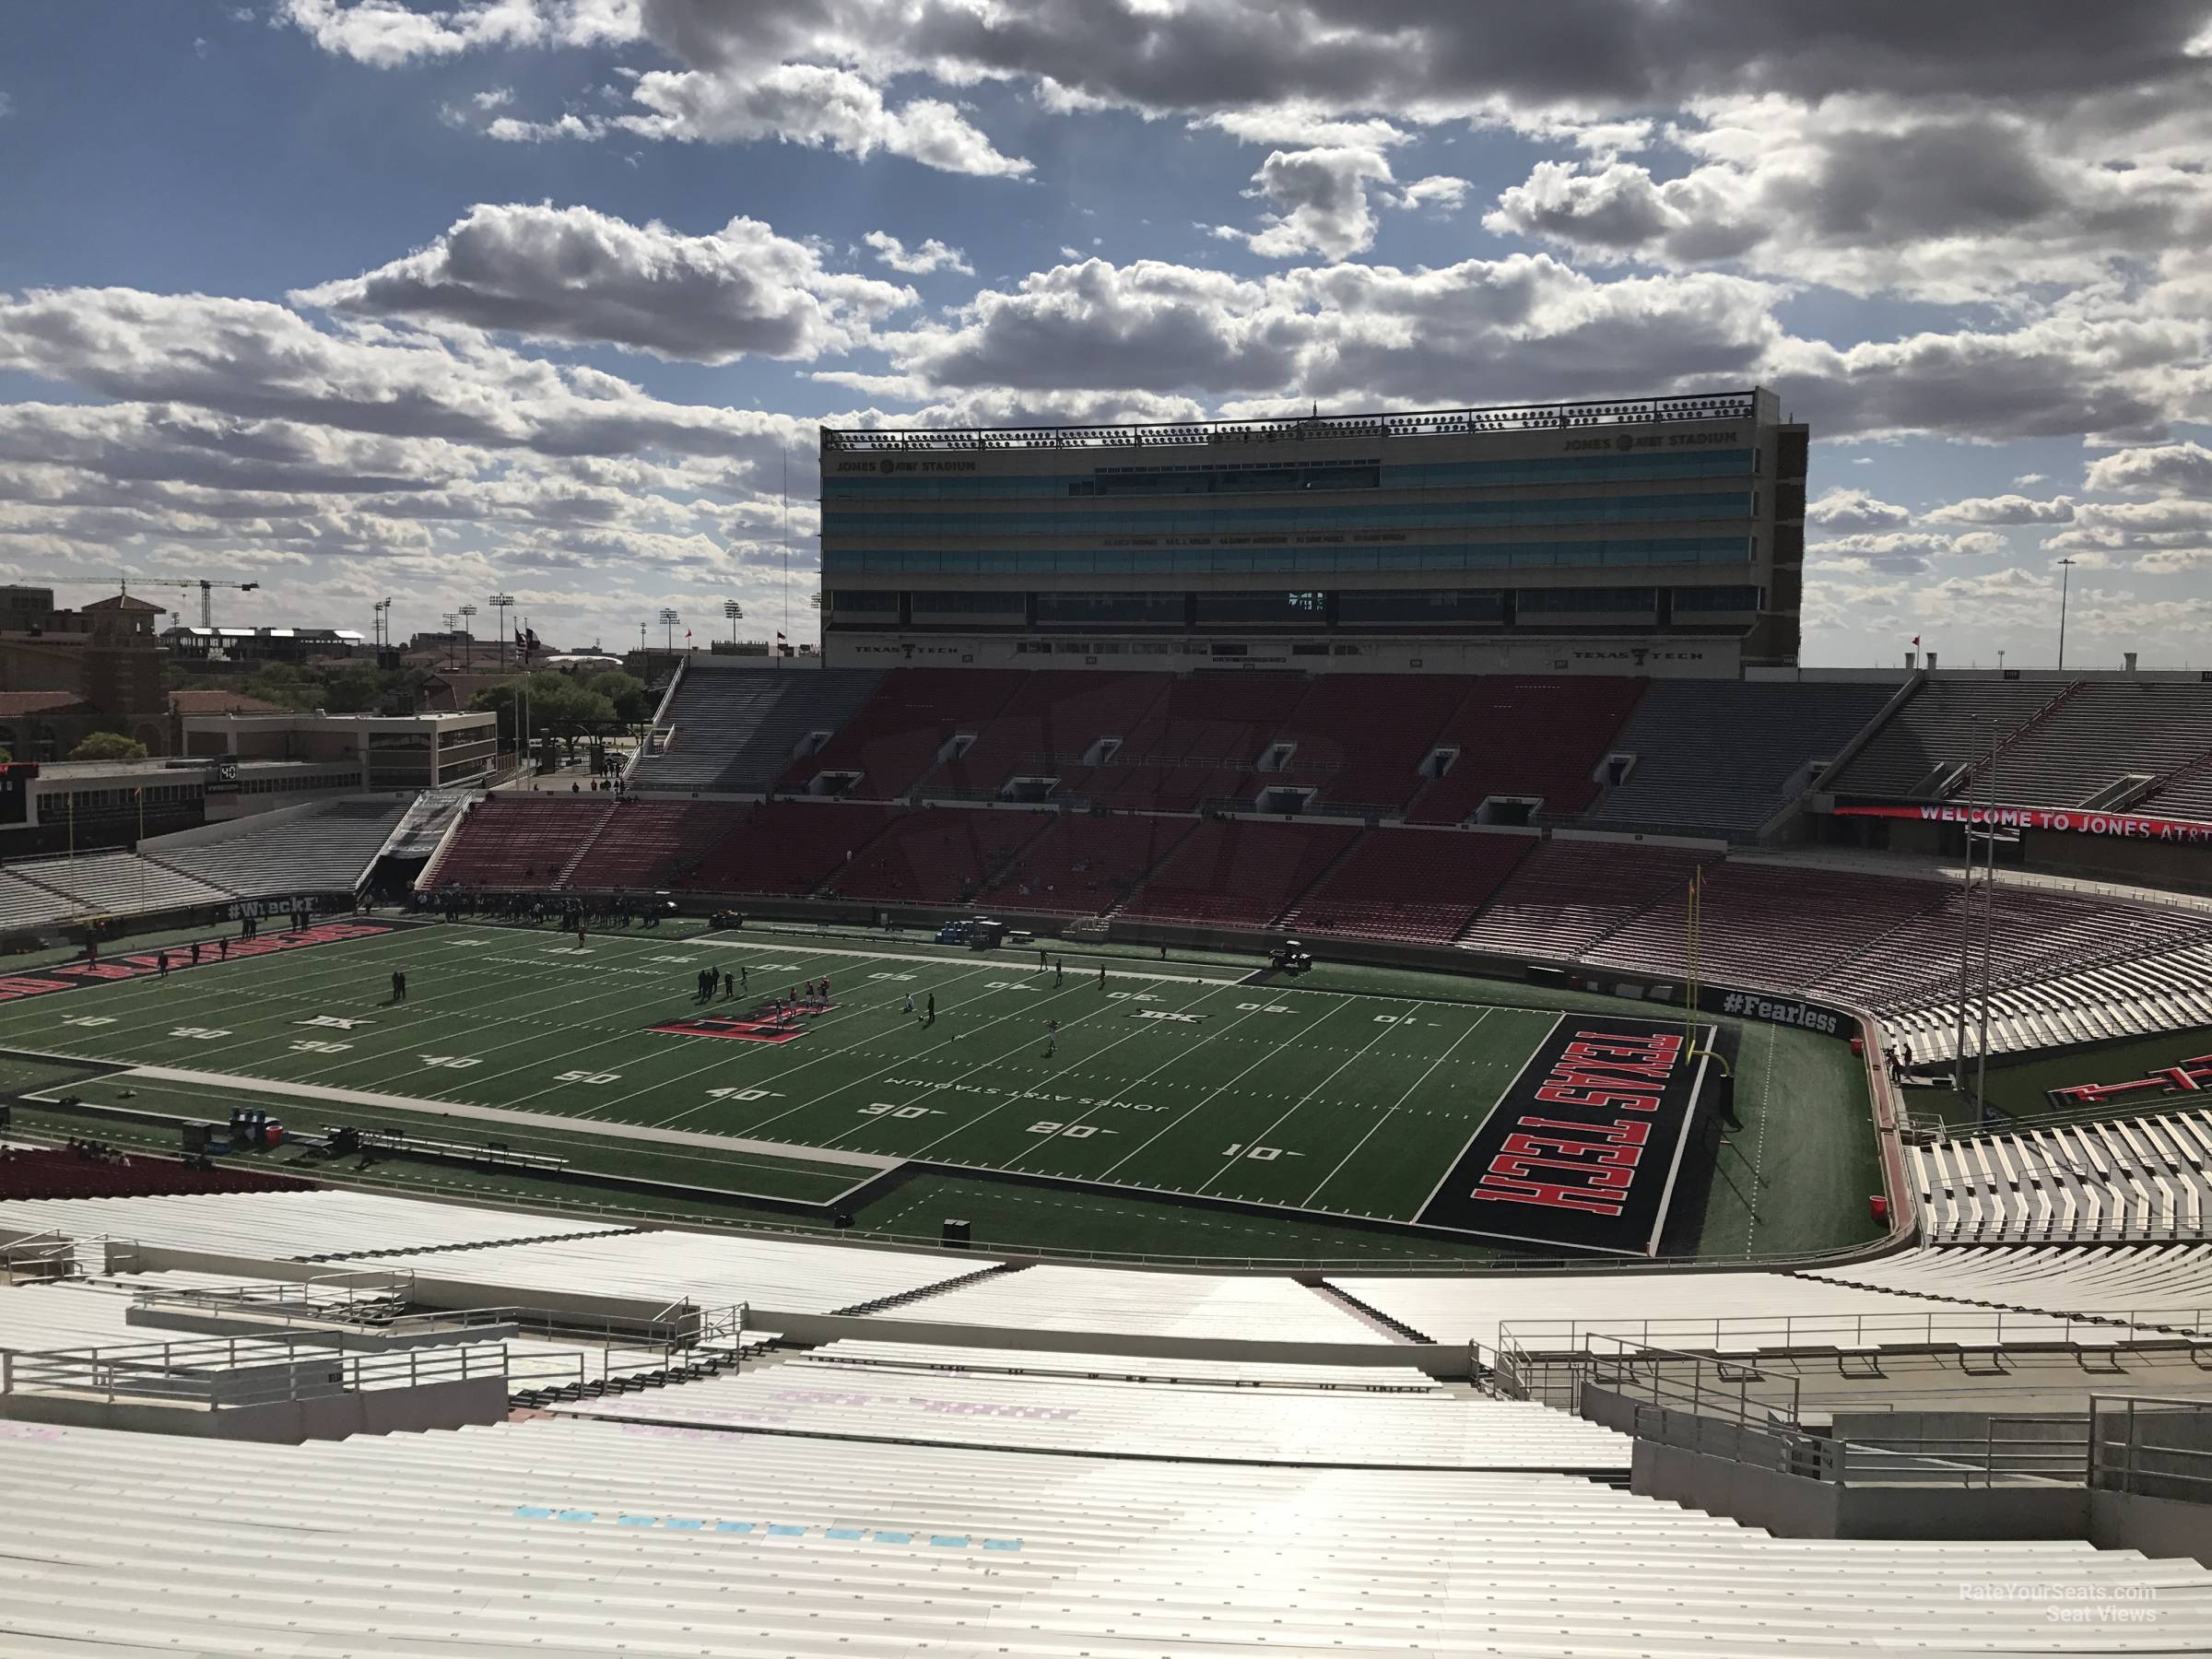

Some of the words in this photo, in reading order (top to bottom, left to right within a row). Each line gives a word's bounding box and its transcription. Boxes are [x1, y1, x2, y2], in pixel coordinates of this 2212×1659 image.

[1563, 439, 1611, 453] JONES
[1668, 430, 1736, 446] STADIUM
[837, 462, 876, 472] JONES
[922, 461, 976, 471] STADIUM
[1573, 651, 1629, 660] TEXAS
[1652, 653, 1702, 661] TECH
[222, 766, 236, 779] 40
[1920, 806, 2031, 829] WELCOME
[2040, 812, 2069, 831] TO
[2077, 815, 2151, 839] JONES
[2159, 825, 2212, 843] AT&T
[1235, 1003, 1288, 1013] 20
[1724, 994, 1837, 1033] #Fearless
[1372, 1015, 1417, 1025] 10
[168, 1027, 233, 1040] 20
[288, 1040, 354, 1053] 30
[421, 1055, 483, 1068] 40
[553, 1070, 622, 1084] 50
[1534, 1030, 1685, 1112] TEXAS
[882, 1077, 1002, 1094] STADIUM
[705, 1087, 771, 1101] 40
[1004, 1089, 1074, 1102] AT&T
[857, 1101, 930, 1119] 30
[1077, 1098, 1171, 1113] JONES
[1026, 1120, 1100, 1139] 20
[1222, 1144, 1284, 1161] 10
[1470, 1115, 1653, 1217] TECH
